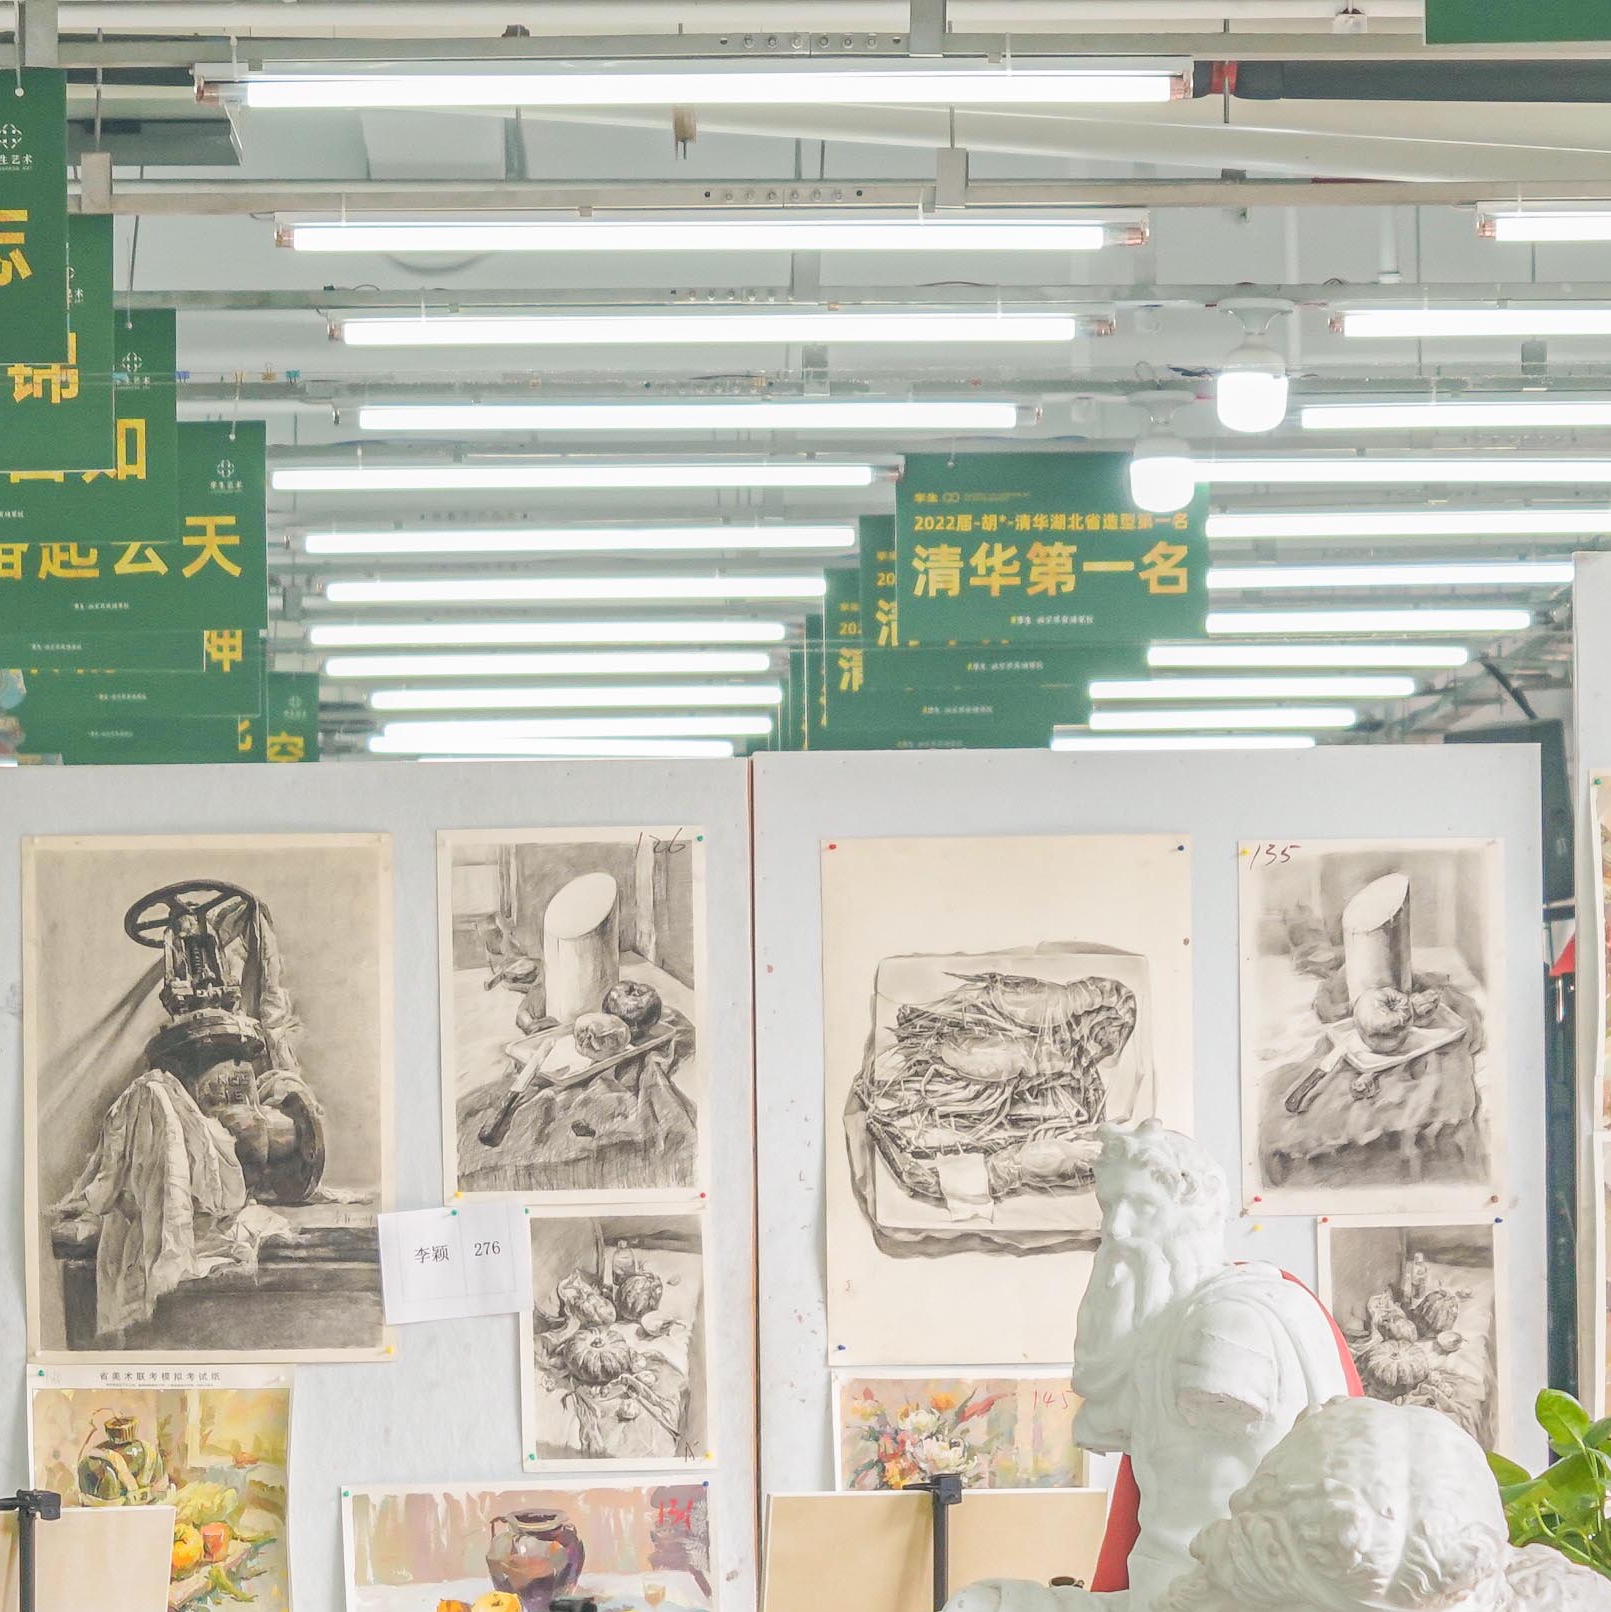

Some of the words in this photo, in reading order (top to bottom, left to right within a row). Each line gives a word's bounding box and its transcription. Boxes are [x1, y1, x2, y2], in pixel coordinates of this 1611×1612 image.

[911, 540, 1189, 598] 清华第一名
[414, 1244, 450, 1264] 李颖
[474, 1240, 502, 1257] 276
